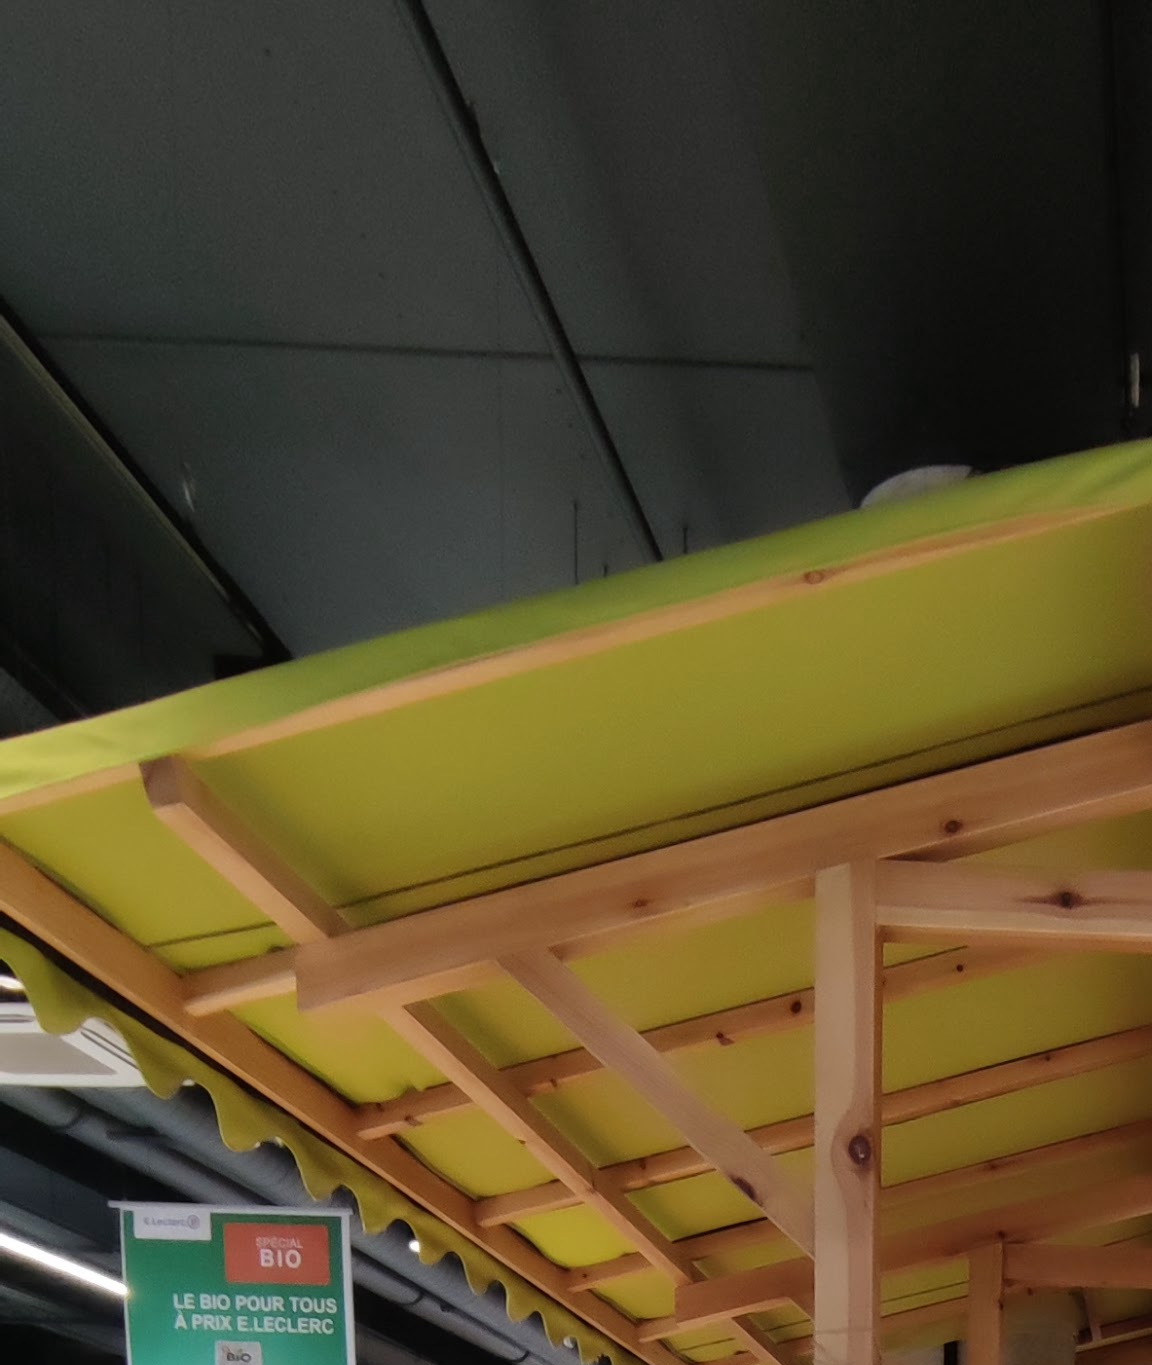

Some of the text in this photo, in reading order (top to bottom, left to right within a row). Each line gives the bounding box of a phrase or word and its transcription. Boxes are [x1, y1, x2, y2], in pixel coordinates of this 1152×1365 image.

[259, 1249, 301, 1268] BIO
[173, 1293, 337, 1313] LE BIO POUR TOUS
[174, 1311, 334, 1335] À PRIX E.LECLERC
